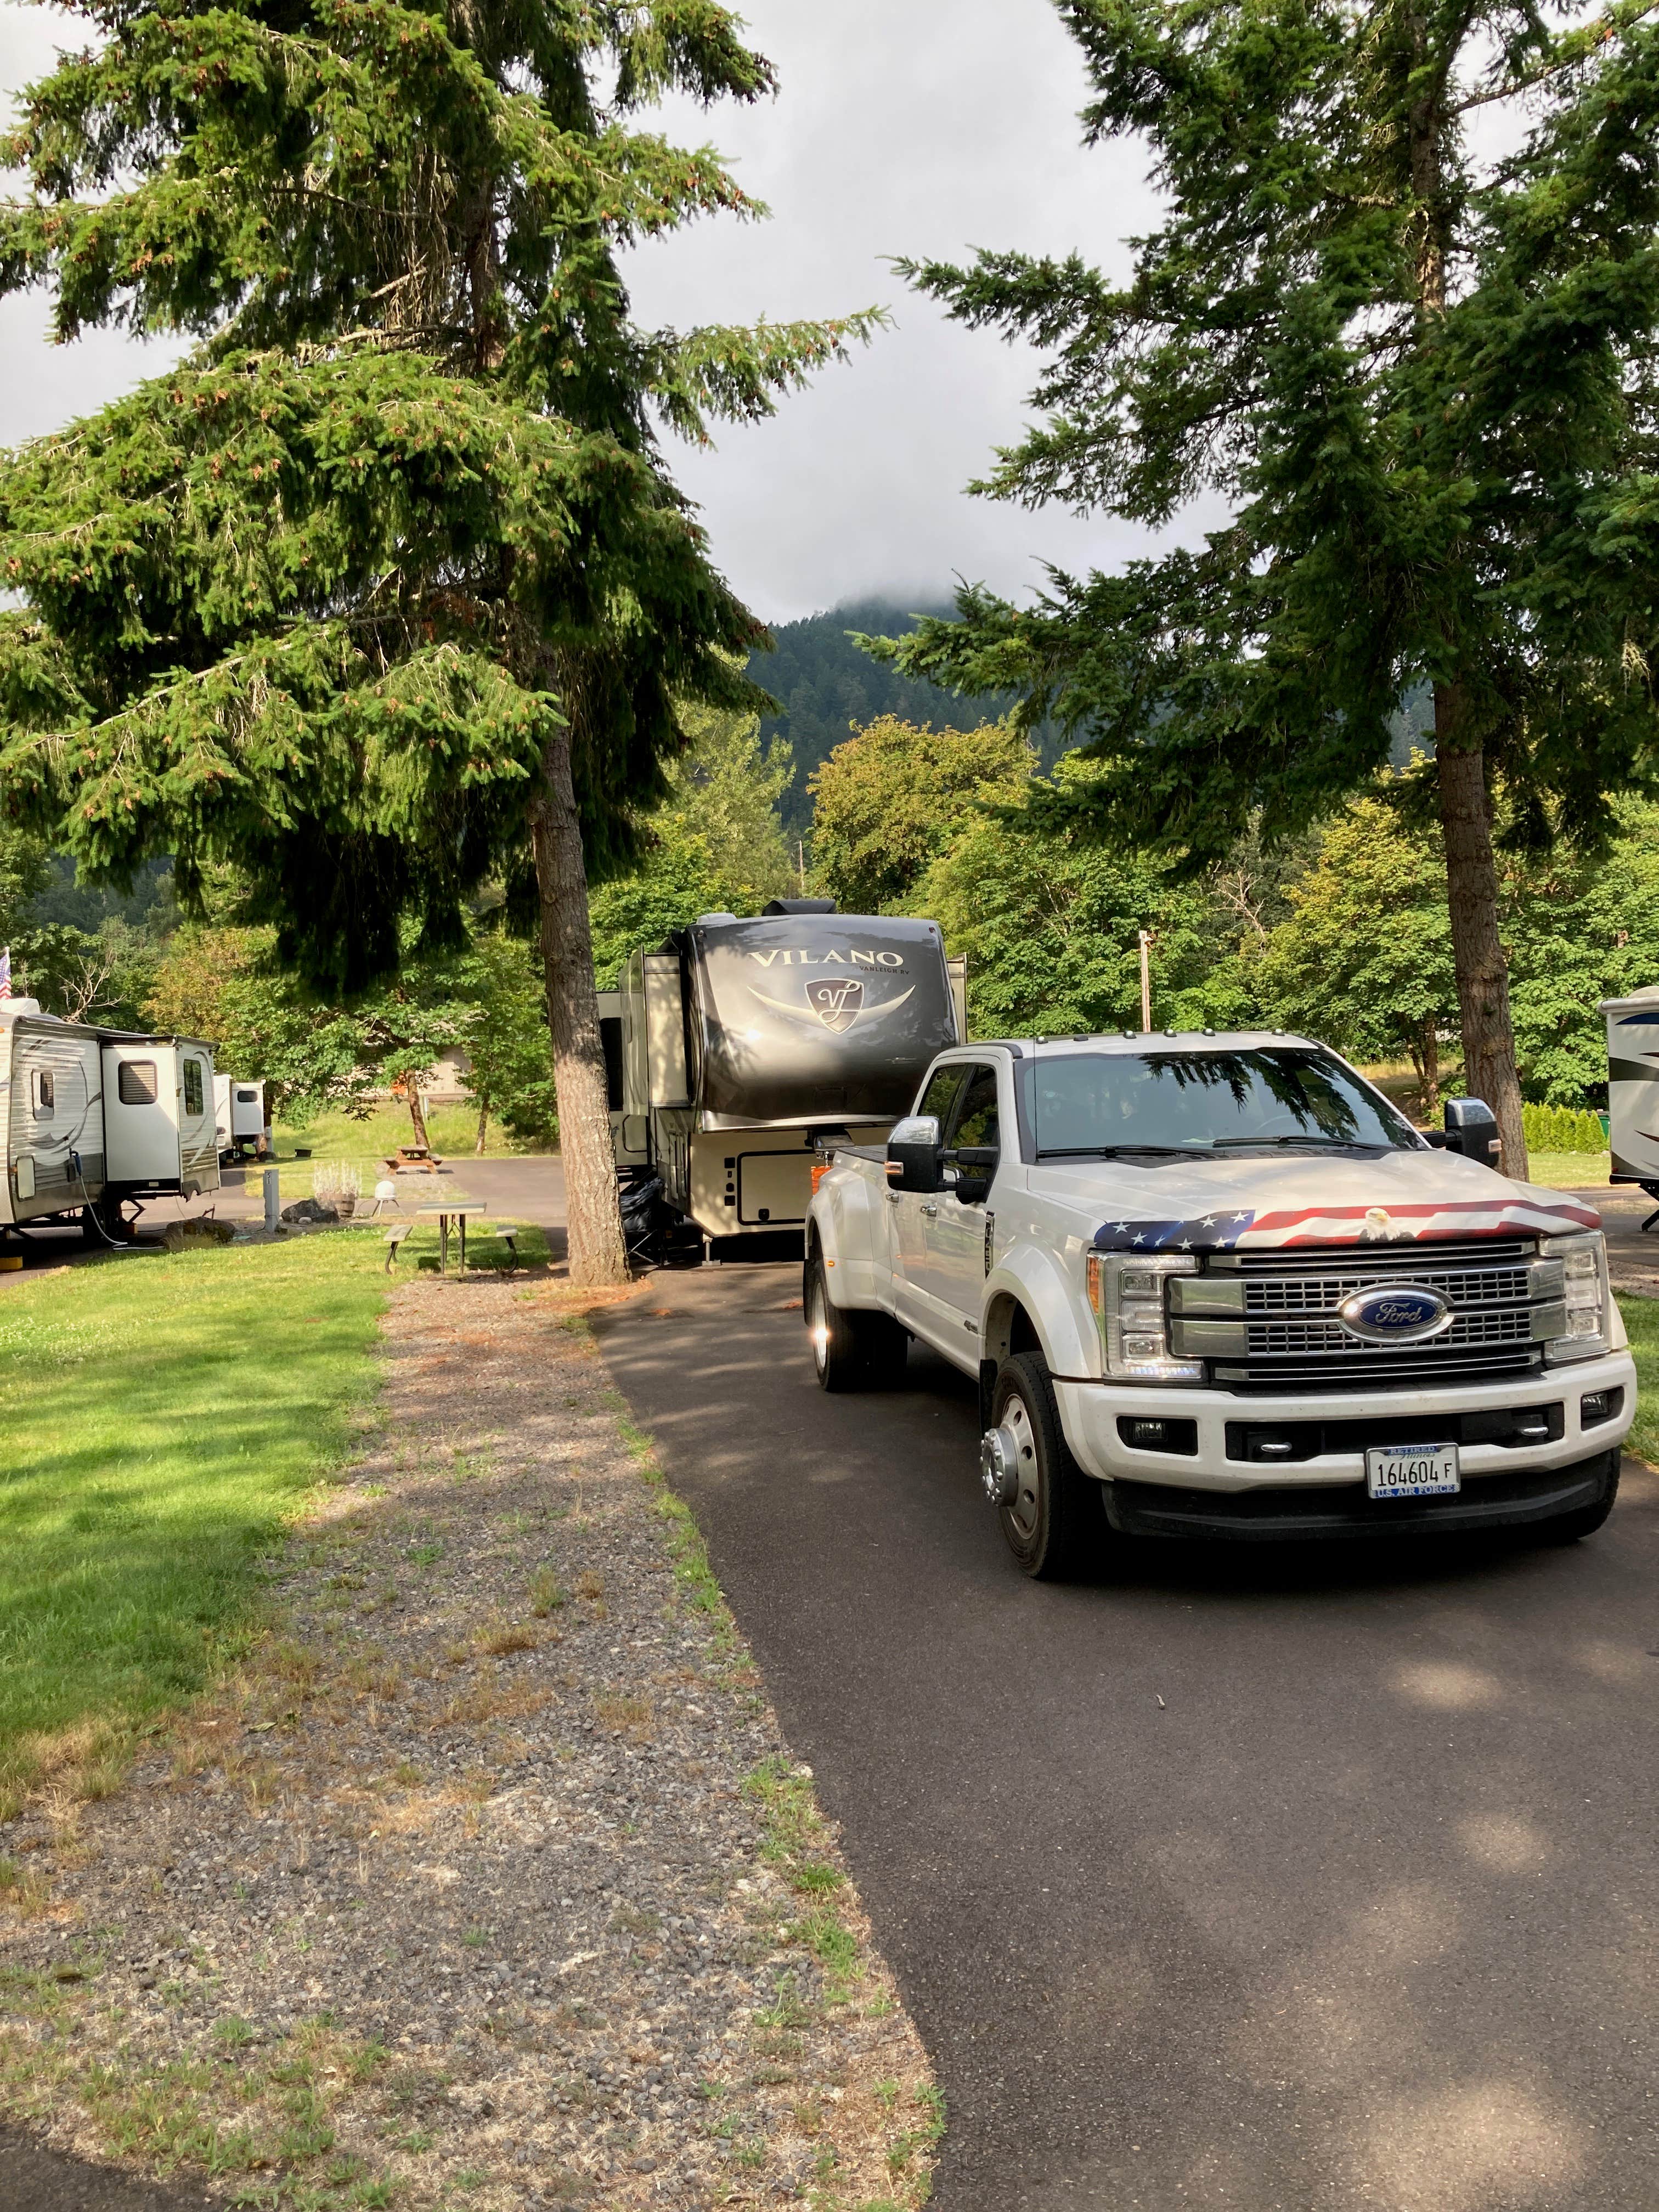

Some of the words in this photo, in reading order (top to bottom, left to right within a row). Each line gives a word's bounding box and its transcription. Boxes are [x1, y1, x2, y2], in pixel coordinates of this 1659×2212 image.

[747, 949, 904, 967] VILANO
[859, 966, 898, 974] VANLEIGH
[1375, 1302, 1422, 1324] Ford
[1390, 1446, 1436, 1454] RETIRED
[1378, 1460, 1438, 1486] 164604
[1444, 1463, 1453, 1478] F
[1399, 1487, 1417, 1496] AIR
[1419, 1484, 1454, 1494] FORCE
